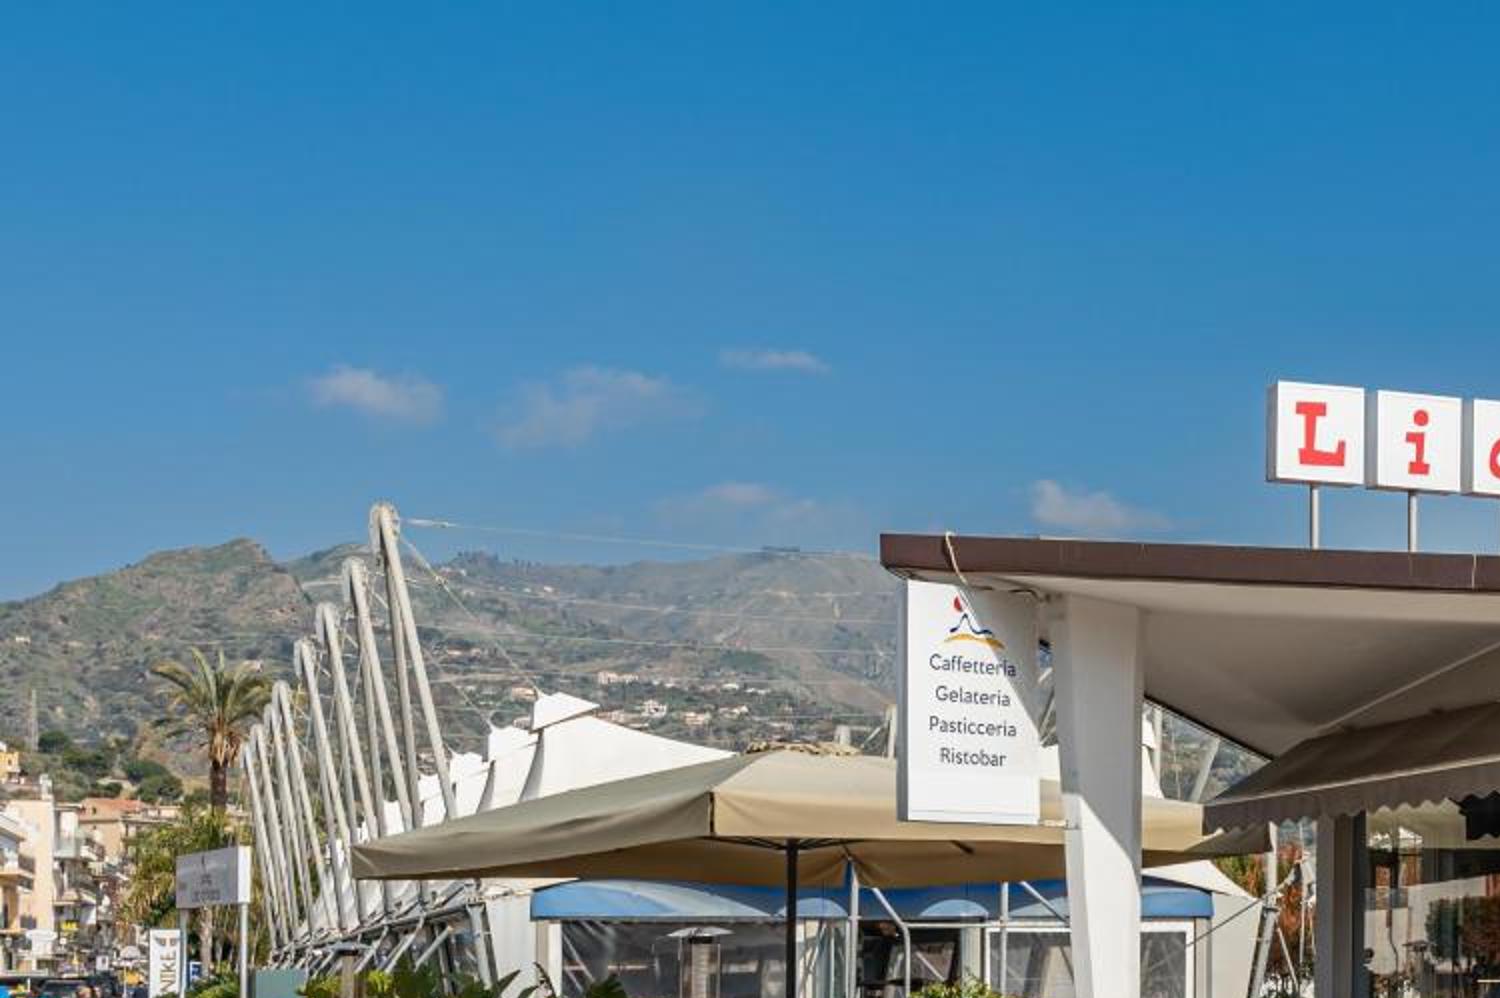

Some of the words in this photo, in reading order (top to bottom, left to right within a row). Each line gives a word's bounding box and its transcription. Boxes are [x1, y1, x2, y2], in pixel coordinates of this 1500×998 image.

[929, 653, 1017, 677] Caffetteria
[935, 685, 1011, 707] Gelateria
[929, 715, 1017, 737] Pasticceria
[940, 747, 1007, 767] Ristobar
[159, 950, 177, 993] NIKE
